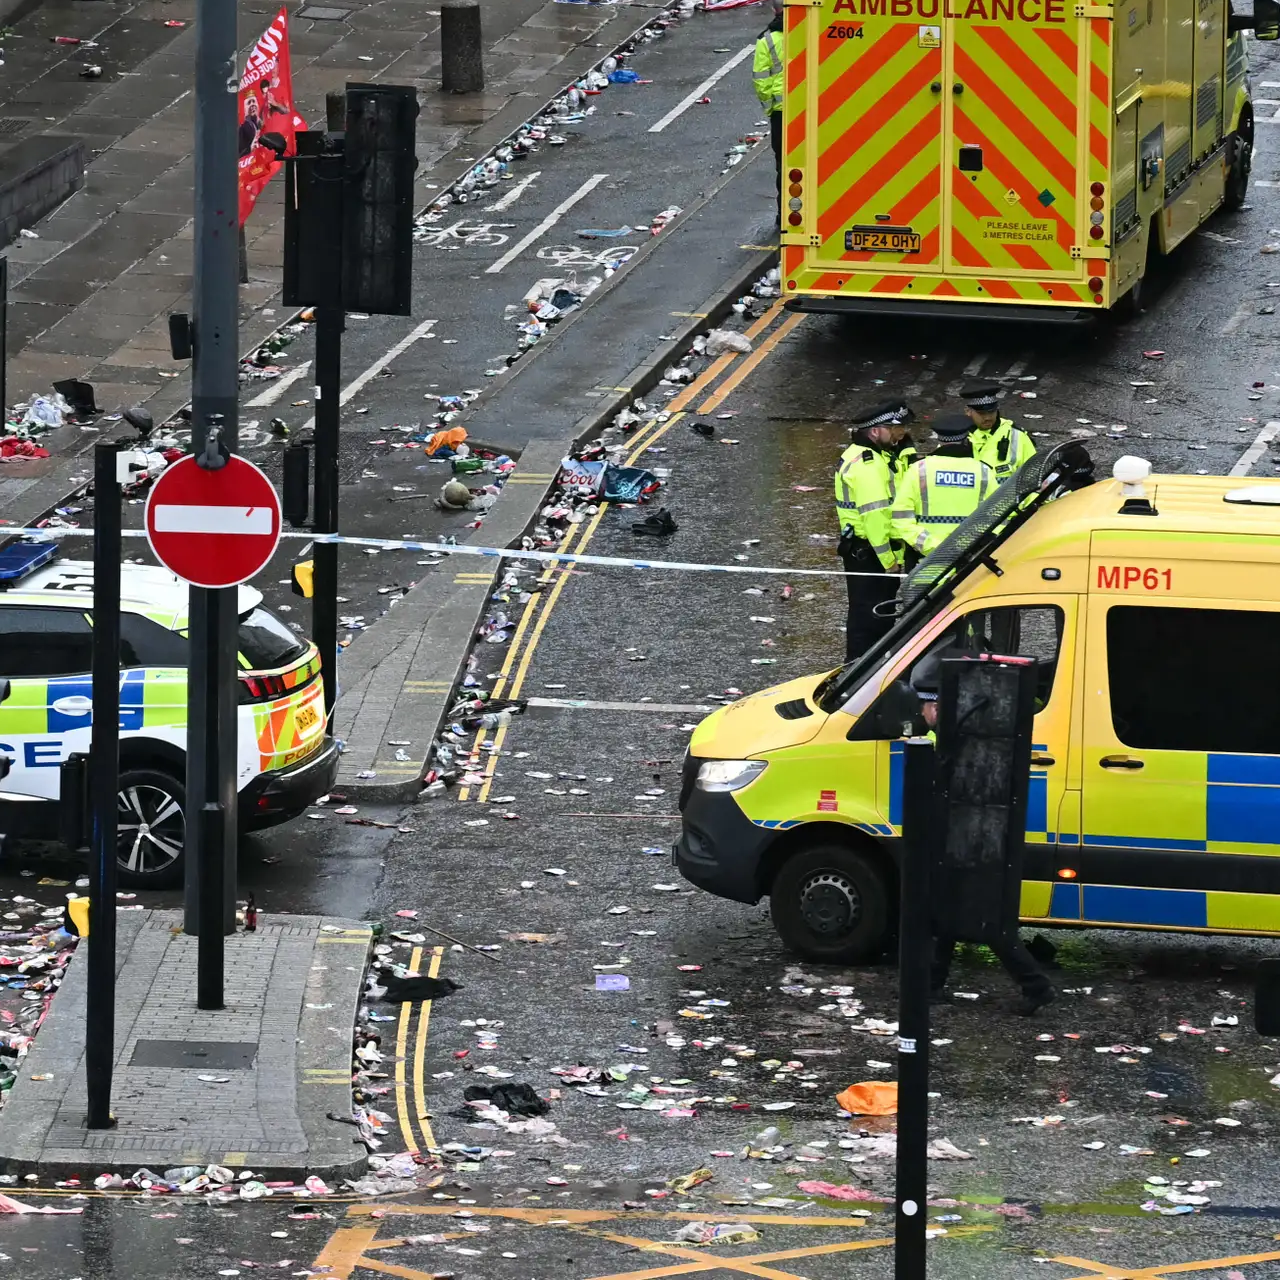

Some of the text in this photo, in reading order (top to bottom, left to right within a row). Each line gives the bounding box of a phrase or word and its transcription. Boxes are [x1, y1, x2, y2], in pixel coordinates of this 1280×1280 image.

[827, 24, 865, 40] Z604
[987, 221, 1048, 231] PLEASE LEAVE
[854, 233, 918, 248] DF24 OHY
[983, 231, 1053, 241] 3 METRES CLEAR
[936, 472, 974, 486] POLICE
[1097, 566, 1173, 590] MP61
